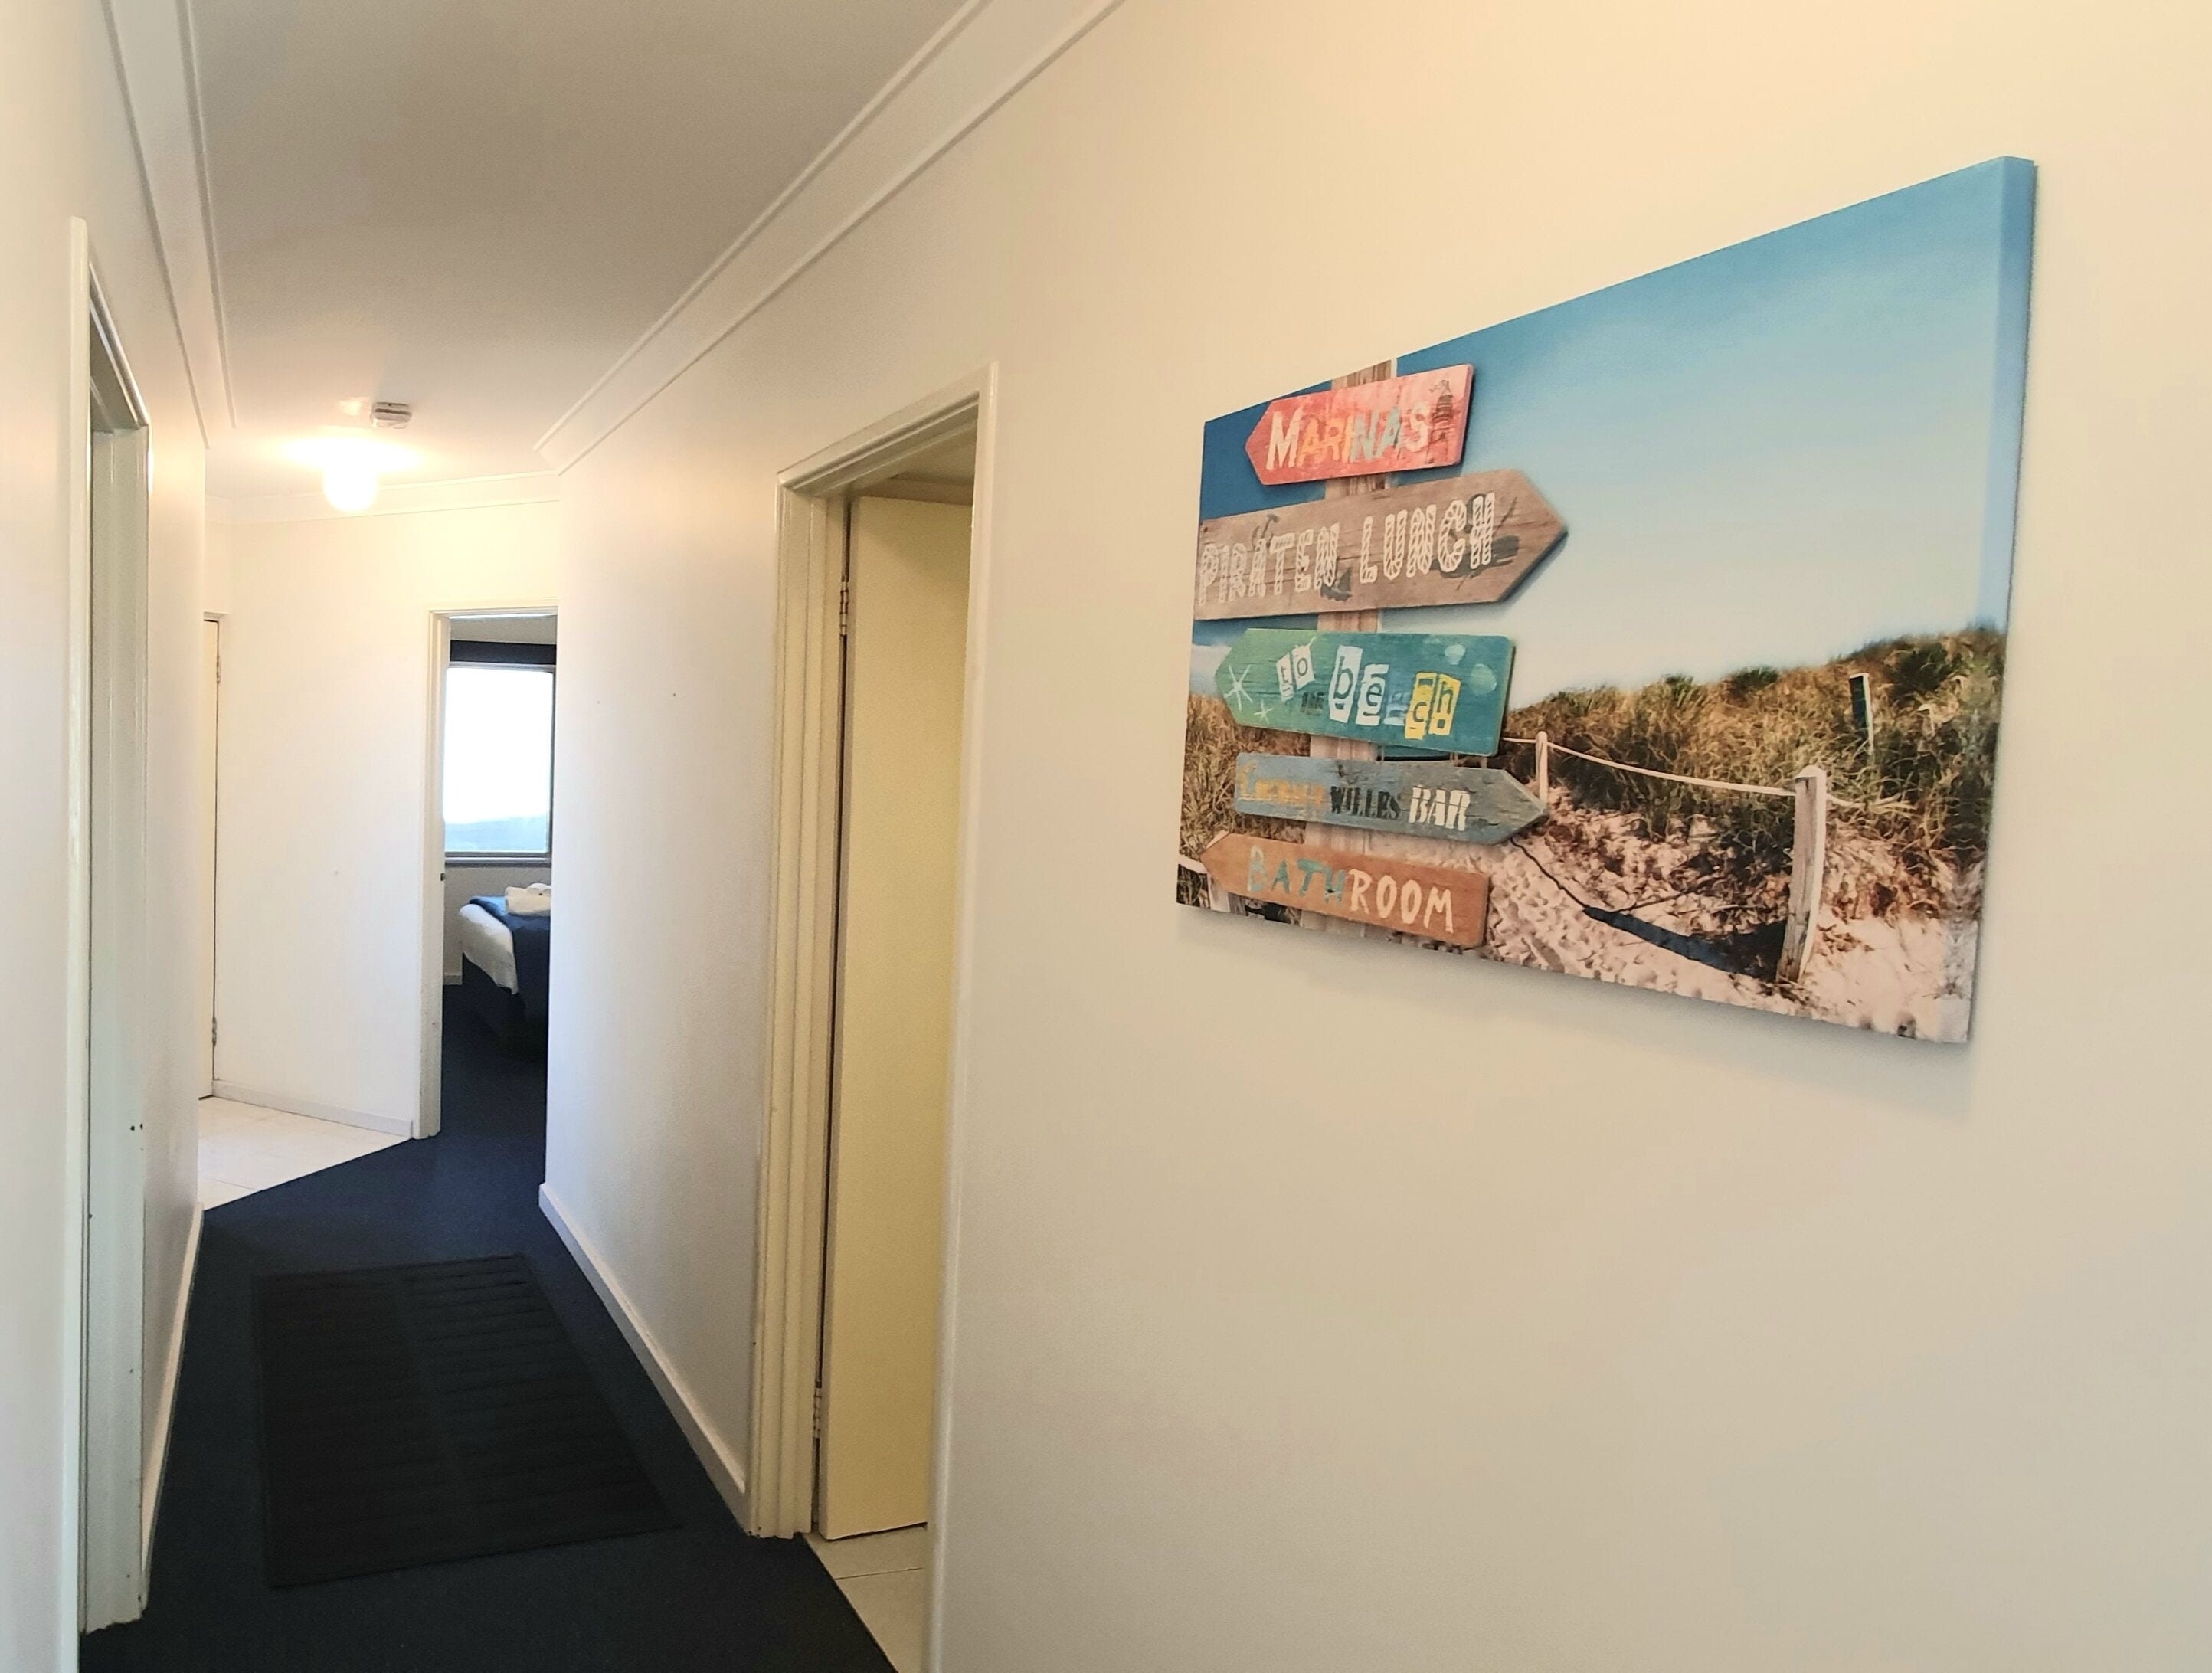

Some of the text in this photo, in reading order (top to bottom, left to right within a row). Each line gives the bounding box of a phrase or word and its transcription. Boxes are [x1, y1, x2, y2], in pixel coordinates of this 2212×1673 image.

[1198, 491, 1495, 606] PIRATEN LUNCH
[1409, 785, 1471, 832] BAR
[1247, 845, 1454, 934] BATHROOM
